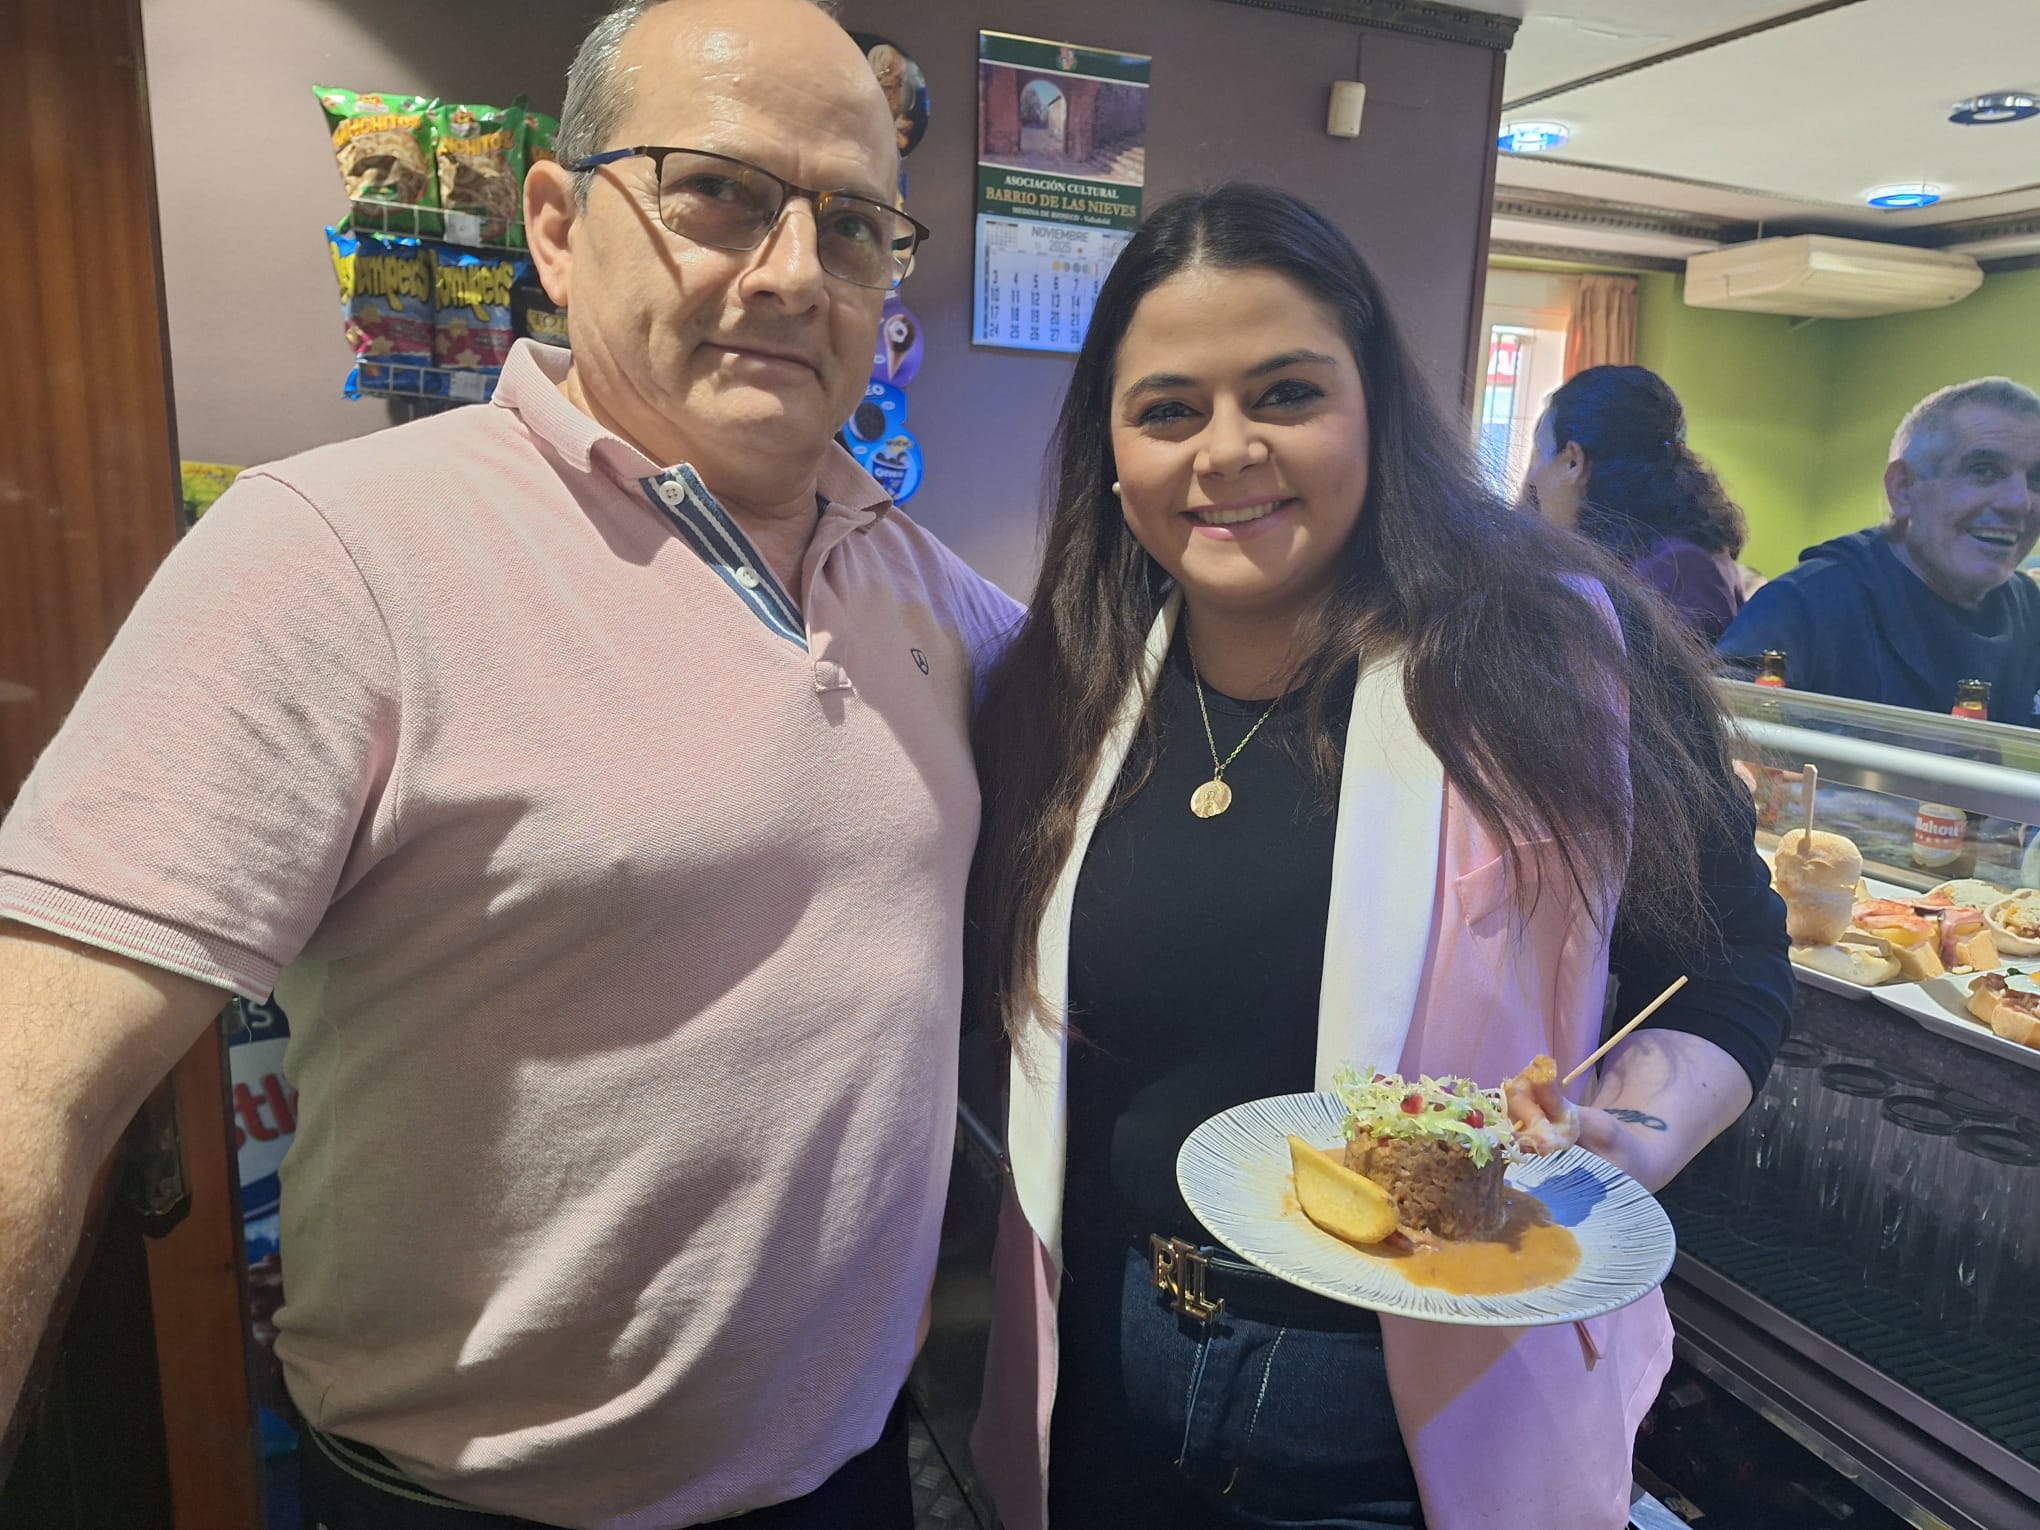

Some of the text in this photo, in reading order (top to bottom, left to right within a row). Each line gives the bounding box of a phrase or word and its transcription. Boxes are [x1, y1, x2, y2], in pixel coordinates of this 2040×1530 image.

[1004, 175, 1119, 200] ASOCIACIÓN CULTURAL
[985, 186, 1137, 218] BARRIO DE LAS NIEVES
[1032, 226, 1089, 243] NOVIEMBRE
